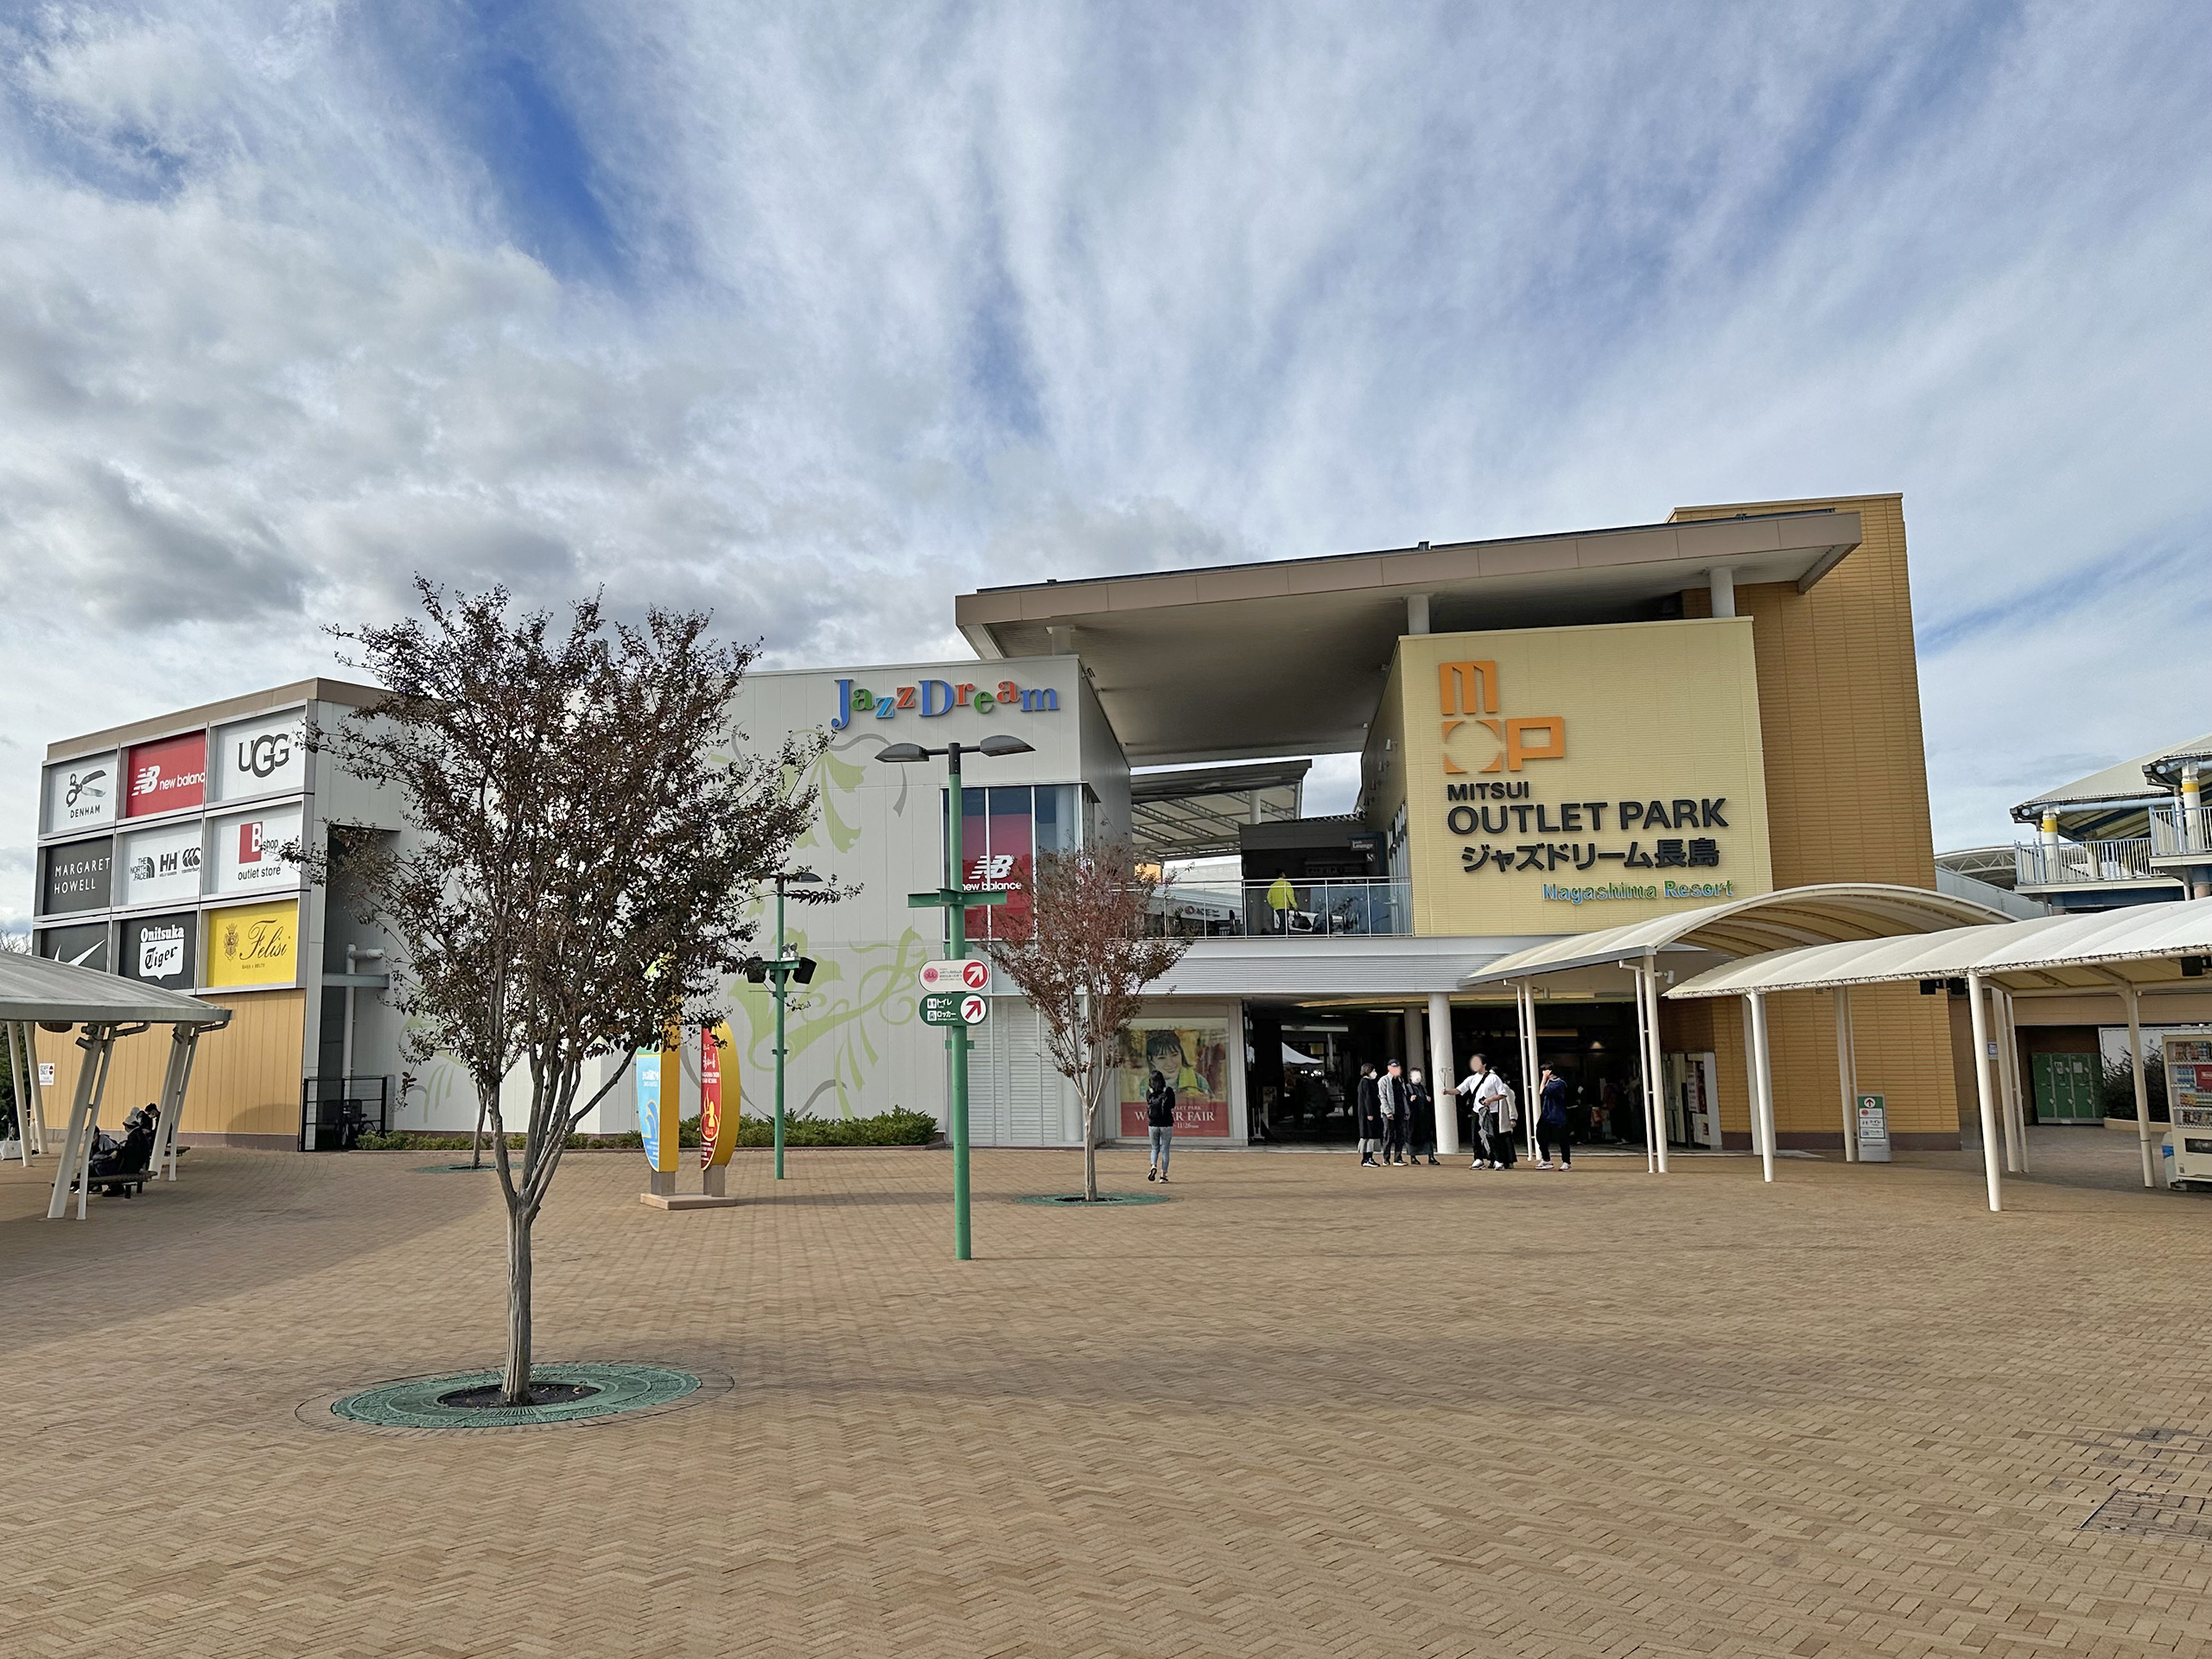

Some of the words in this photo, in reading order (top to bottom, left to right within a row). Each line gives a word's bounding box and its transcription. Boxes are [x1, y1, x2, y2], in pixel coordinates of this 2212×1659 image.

[238, 733, 290, 778] UGG
[159, 778, 177, 791] new
[176, 772, 206, 787] balanc
[1446, 781, 1529, 802] MITSUI
[70, 804, 100, 818] DENHAM
[1446, 801, 1608, 836] OUTLET
[1618, 798, 1730, 830] PARK
[137, 856, 147, 865] THE
[160, 852, 178, 872] HH
[1461, 837, 1720, 873] ジャズドリーム長島
[54, 857, 111, 878] MARGARET
[130, 865, 147, 874] NORTH
[133, 873, 147, 881] FACE
[238, 868, 259, 880] outlet
[261, 866, 281, 877] store
[54, 878, 96, 895] HOWELL
[982, 881, 1022, 891] balance
[1542, 881, 1658, 905] Nagashima
[1663, 880, 1733, 898] Resort
[140, 924, 185, 943] Onitsuka
[239, 918, 291, 960] Felisi
[144, 946, 178, 969] Tiger
[1187, 1111, 1215, 1122] FAIR
